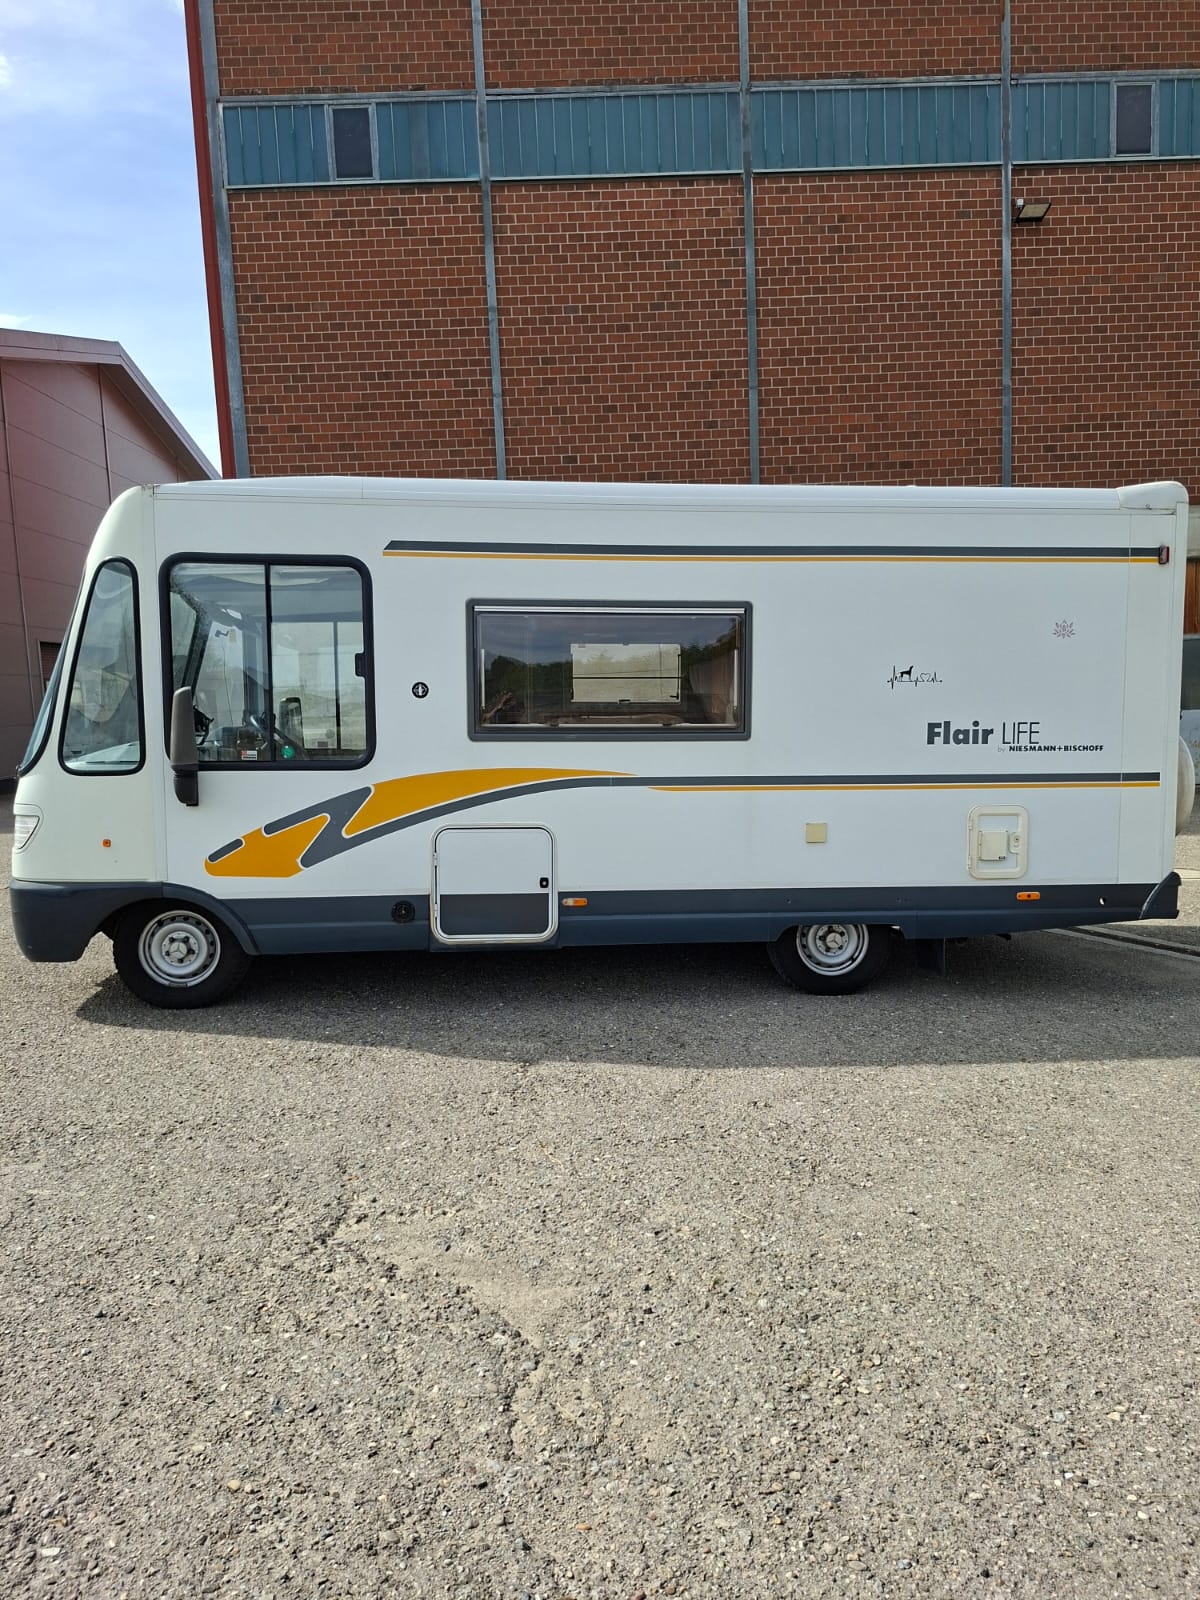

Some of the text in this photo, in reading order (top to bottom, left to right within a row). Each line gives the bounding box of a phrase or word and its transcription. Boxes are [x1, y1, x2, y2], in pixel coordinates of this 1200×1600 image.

[927, 720, 1040, 745] Flair LIFE
[998, 745, 1006, 753] by
